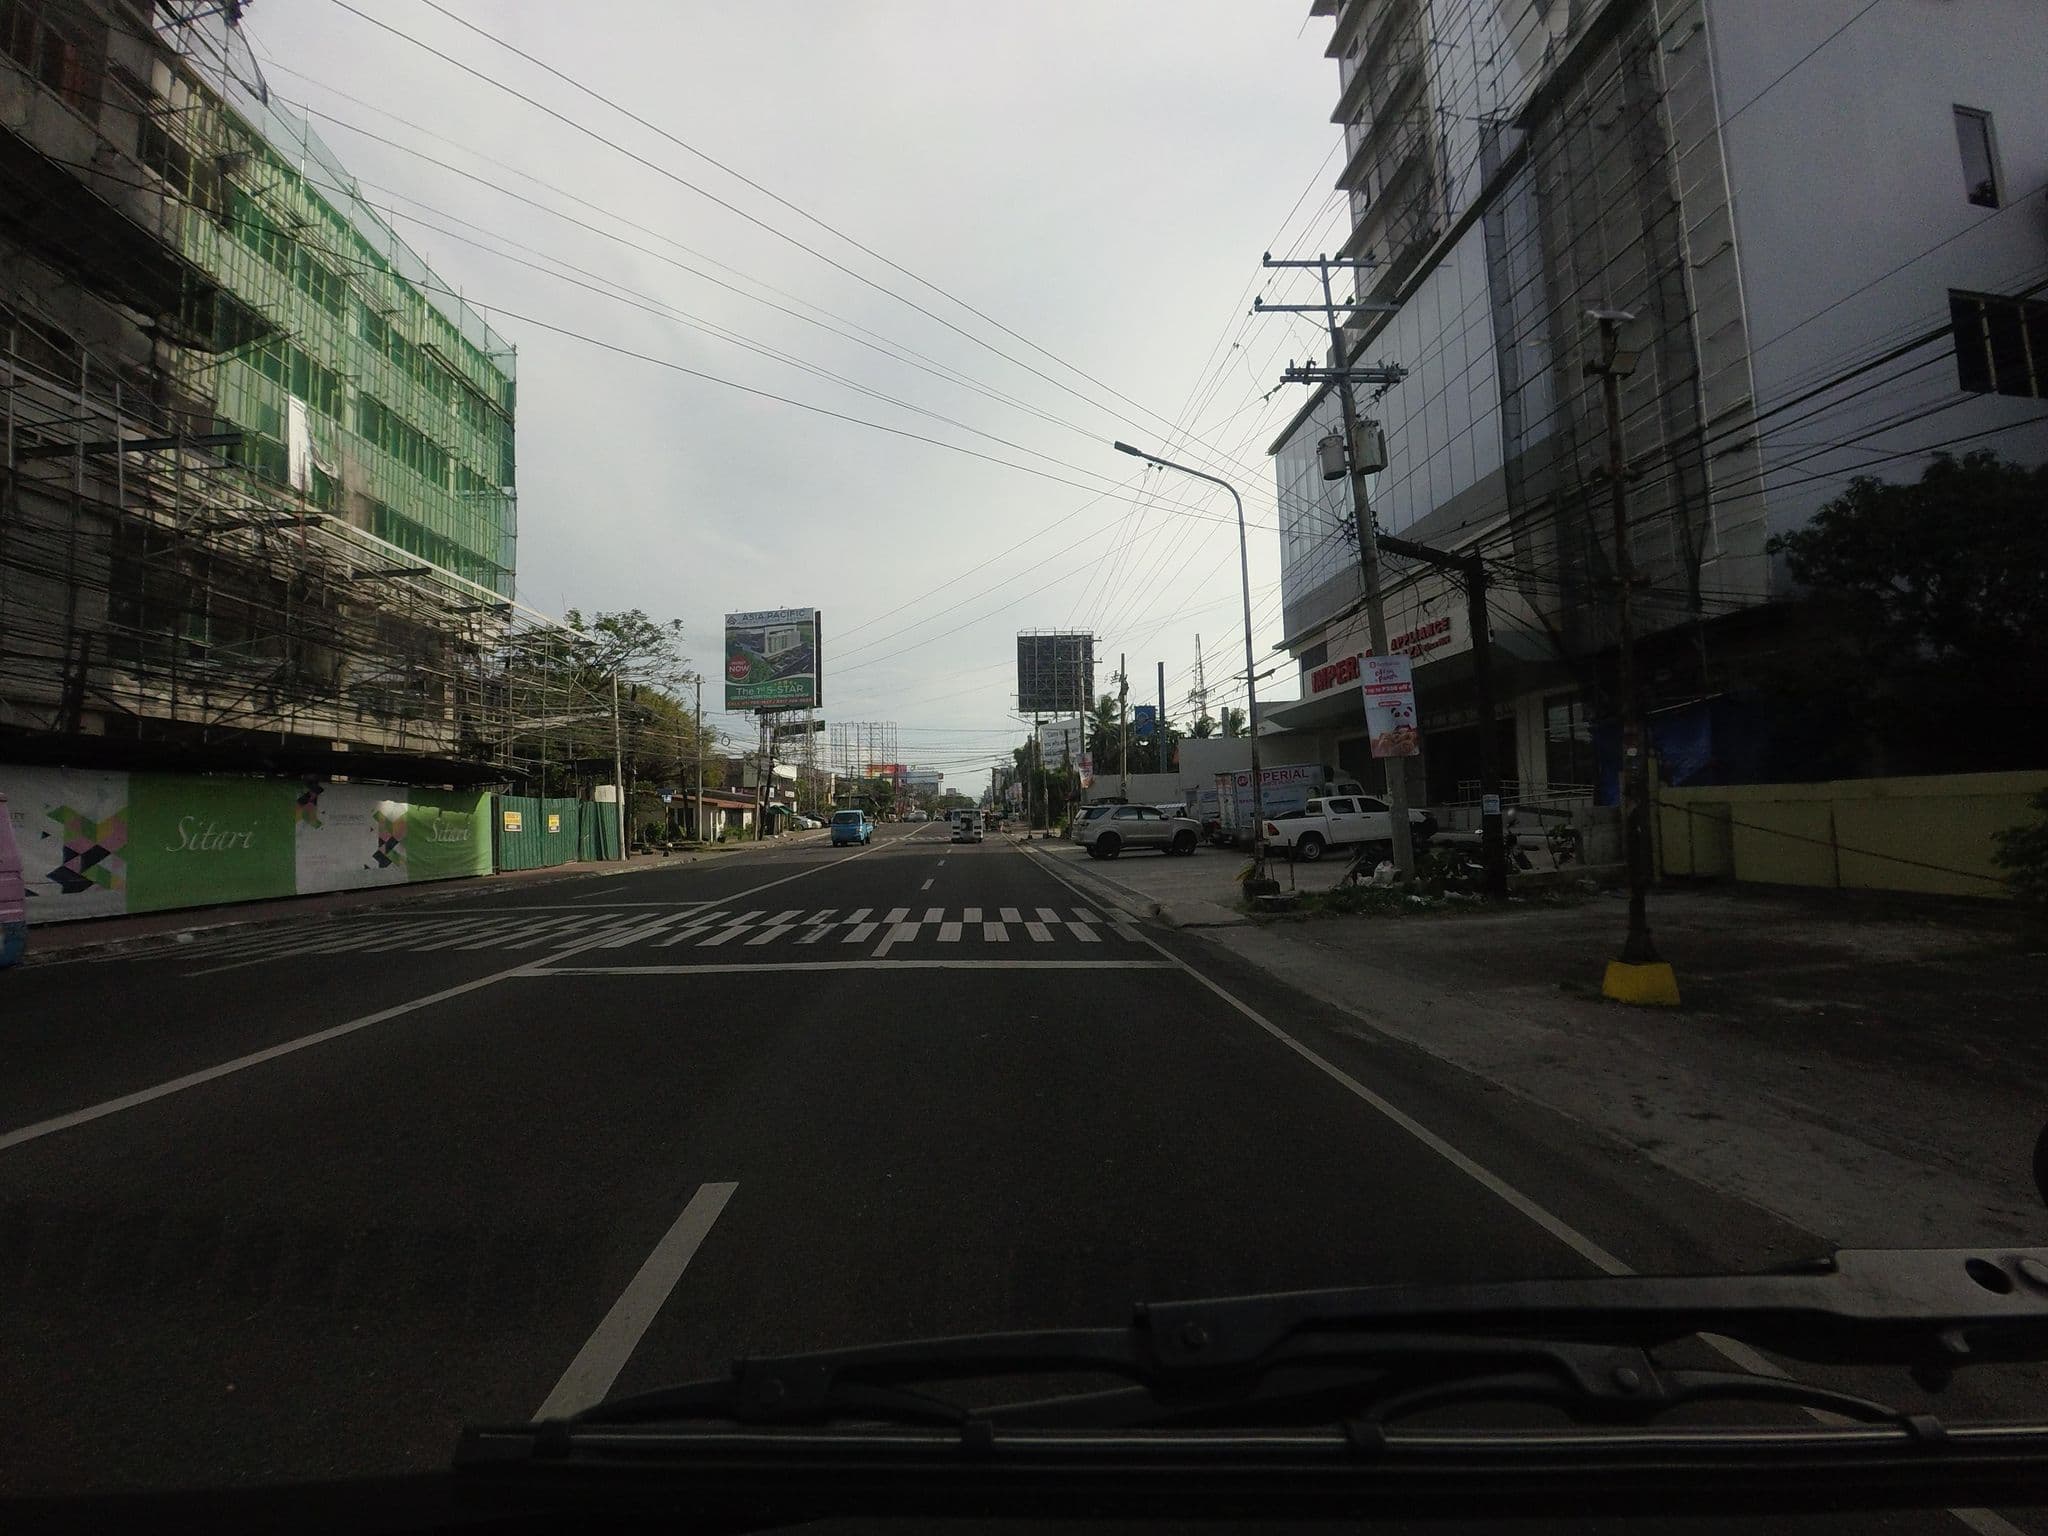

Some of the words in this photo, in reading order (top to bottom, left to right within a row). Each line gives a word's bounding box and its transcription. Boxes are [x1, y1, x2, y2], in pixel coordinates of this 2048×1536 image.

[742, 613, 764, 621] ASIA
[767, 609, 805, 620] PACIFIC
[1391, 617, 1451, 651] APPLIANCE
[728, 665, 751, 673] NOW
[736, 687, 754, 696] The
[767, 684, 804, 695] 5-STAR
[1249, 769, 1309, 785] IPERIAL
[166, 815, 257, 852] Sitari
[426, 817, 471, 842] Sitari
